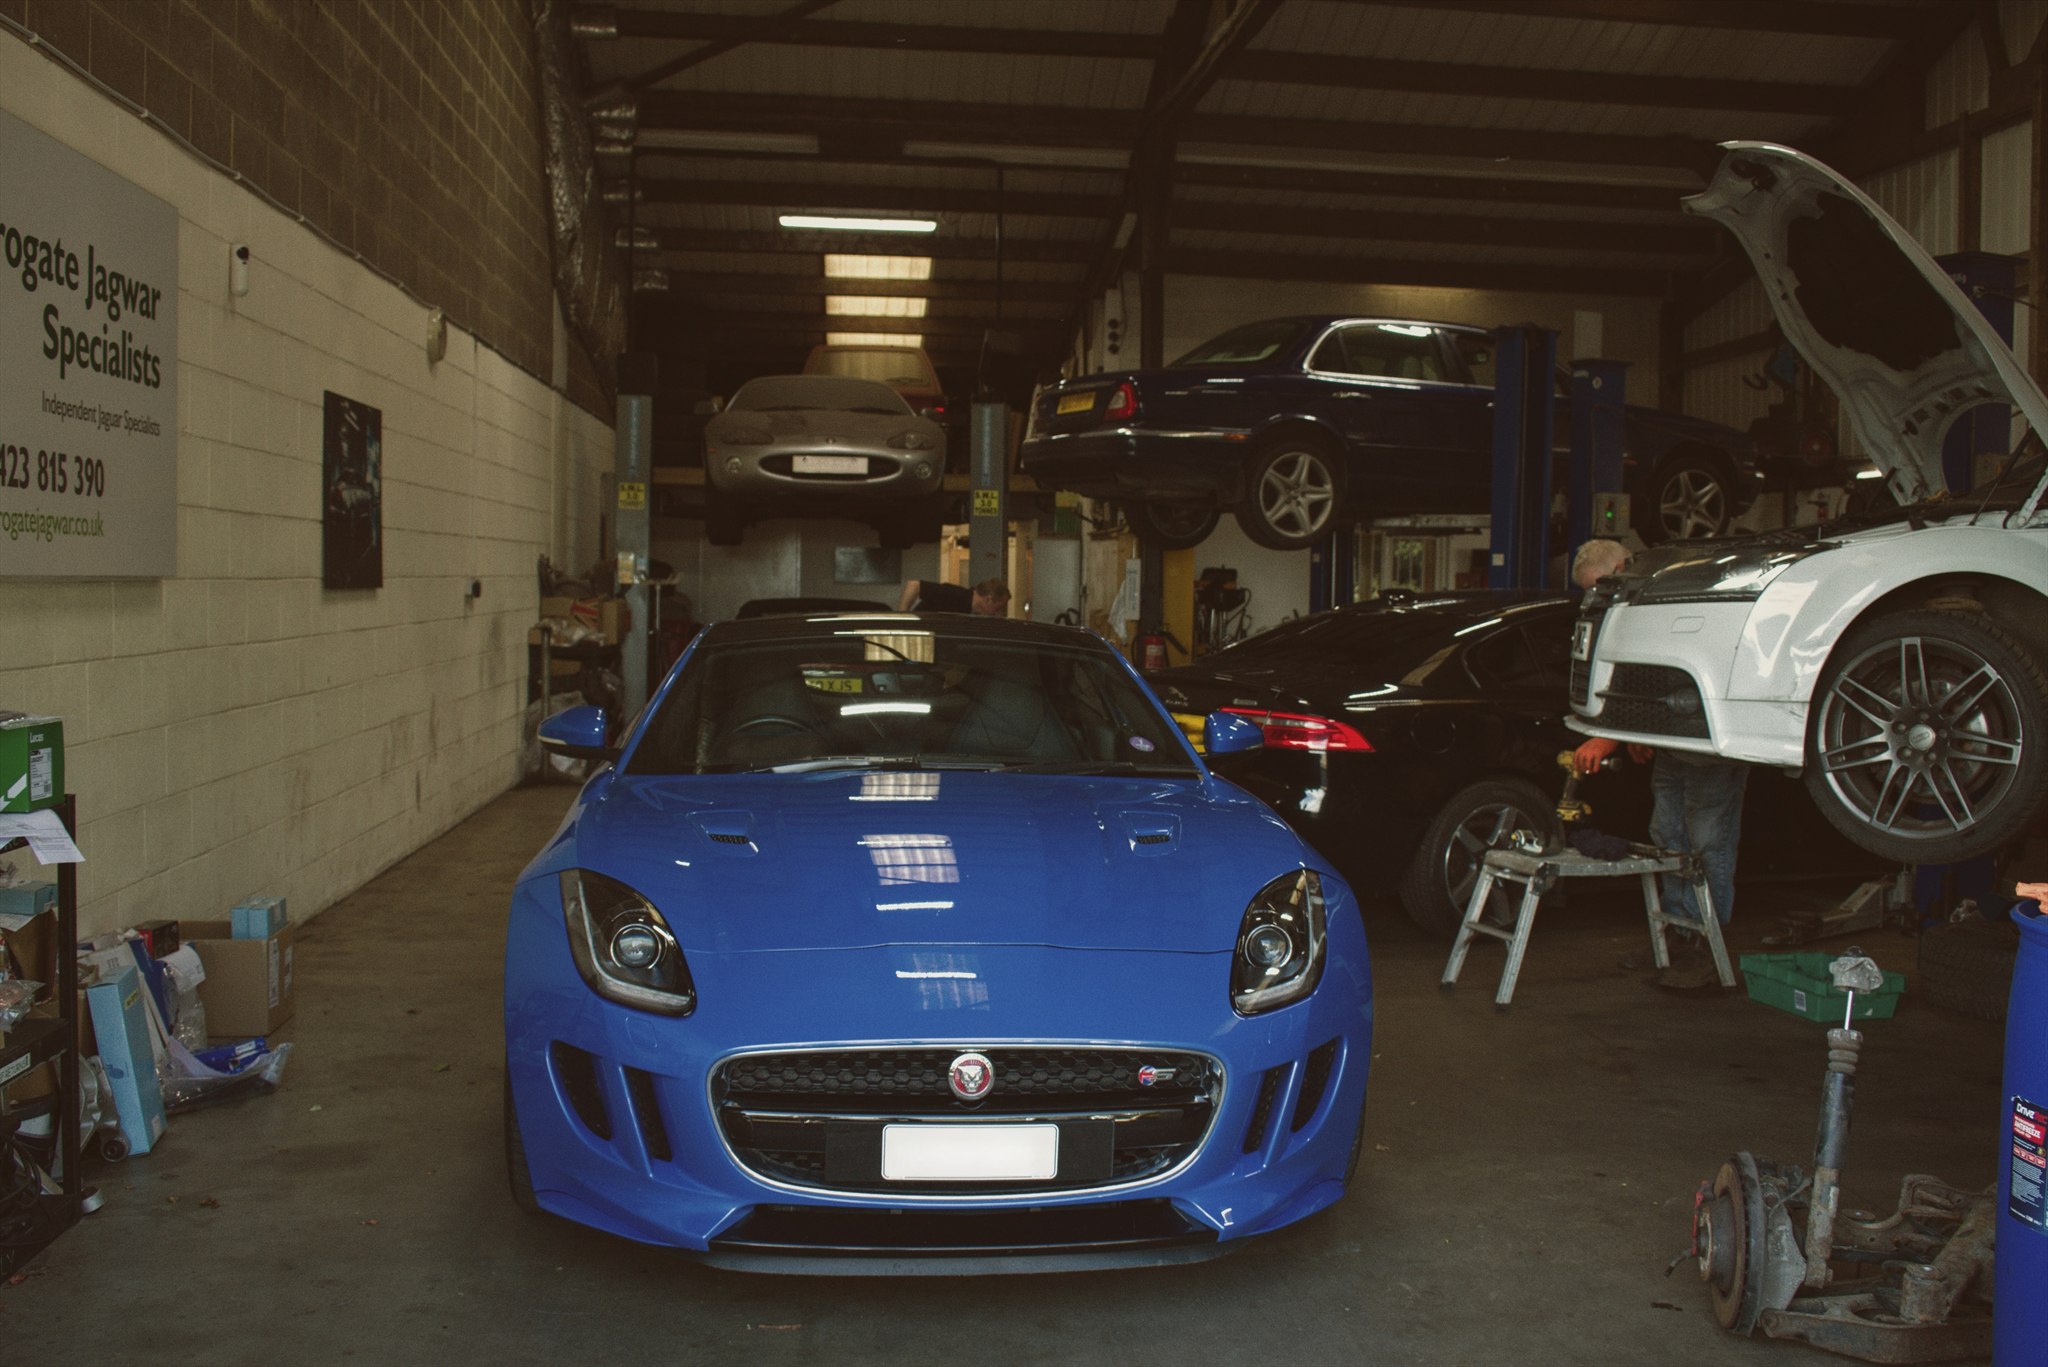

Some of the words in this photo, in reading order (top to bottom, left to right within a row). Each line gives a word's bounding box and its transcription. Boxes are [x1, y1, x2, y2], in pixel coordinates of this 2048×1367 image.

[0, 223, 79, 292] ogate
[85, 244, 161, 322] Jagwar
[43, 303, 161, 389] Specialists
[42, 390, 97, 423] Independent
[97, 404, 122, 431] Jaguar
[124, 409, 160, 436] Specialists
[38, 450, 67, 493] 815
[74, 456, 104, 497] 390
